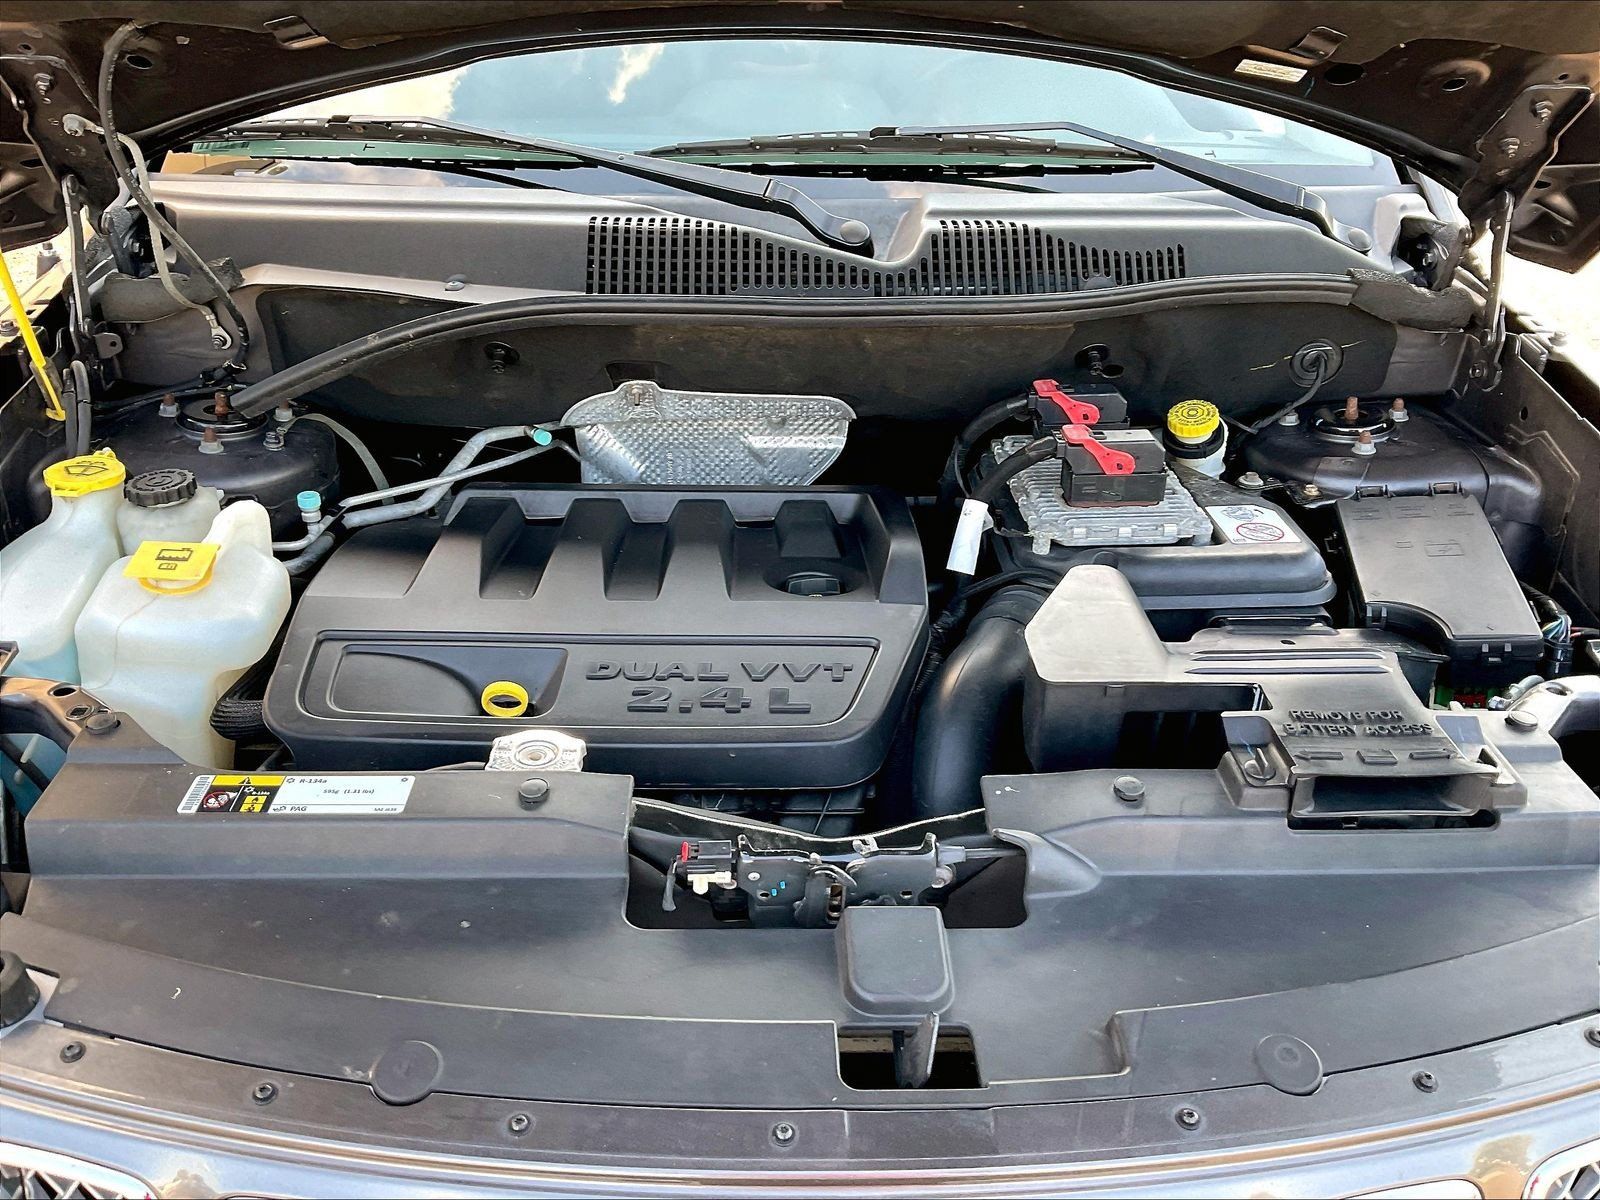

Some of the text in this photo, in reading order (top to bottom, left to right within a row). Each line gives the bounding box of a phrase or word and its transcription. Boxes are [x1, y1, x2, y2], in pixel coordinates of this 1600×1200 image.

[586, 661, 854, 682] DUAL VVT
[1288, 709, 1404, 723] REMOVE FOR
[1282, 723, 1434, 737] BATTERY ACCESS
